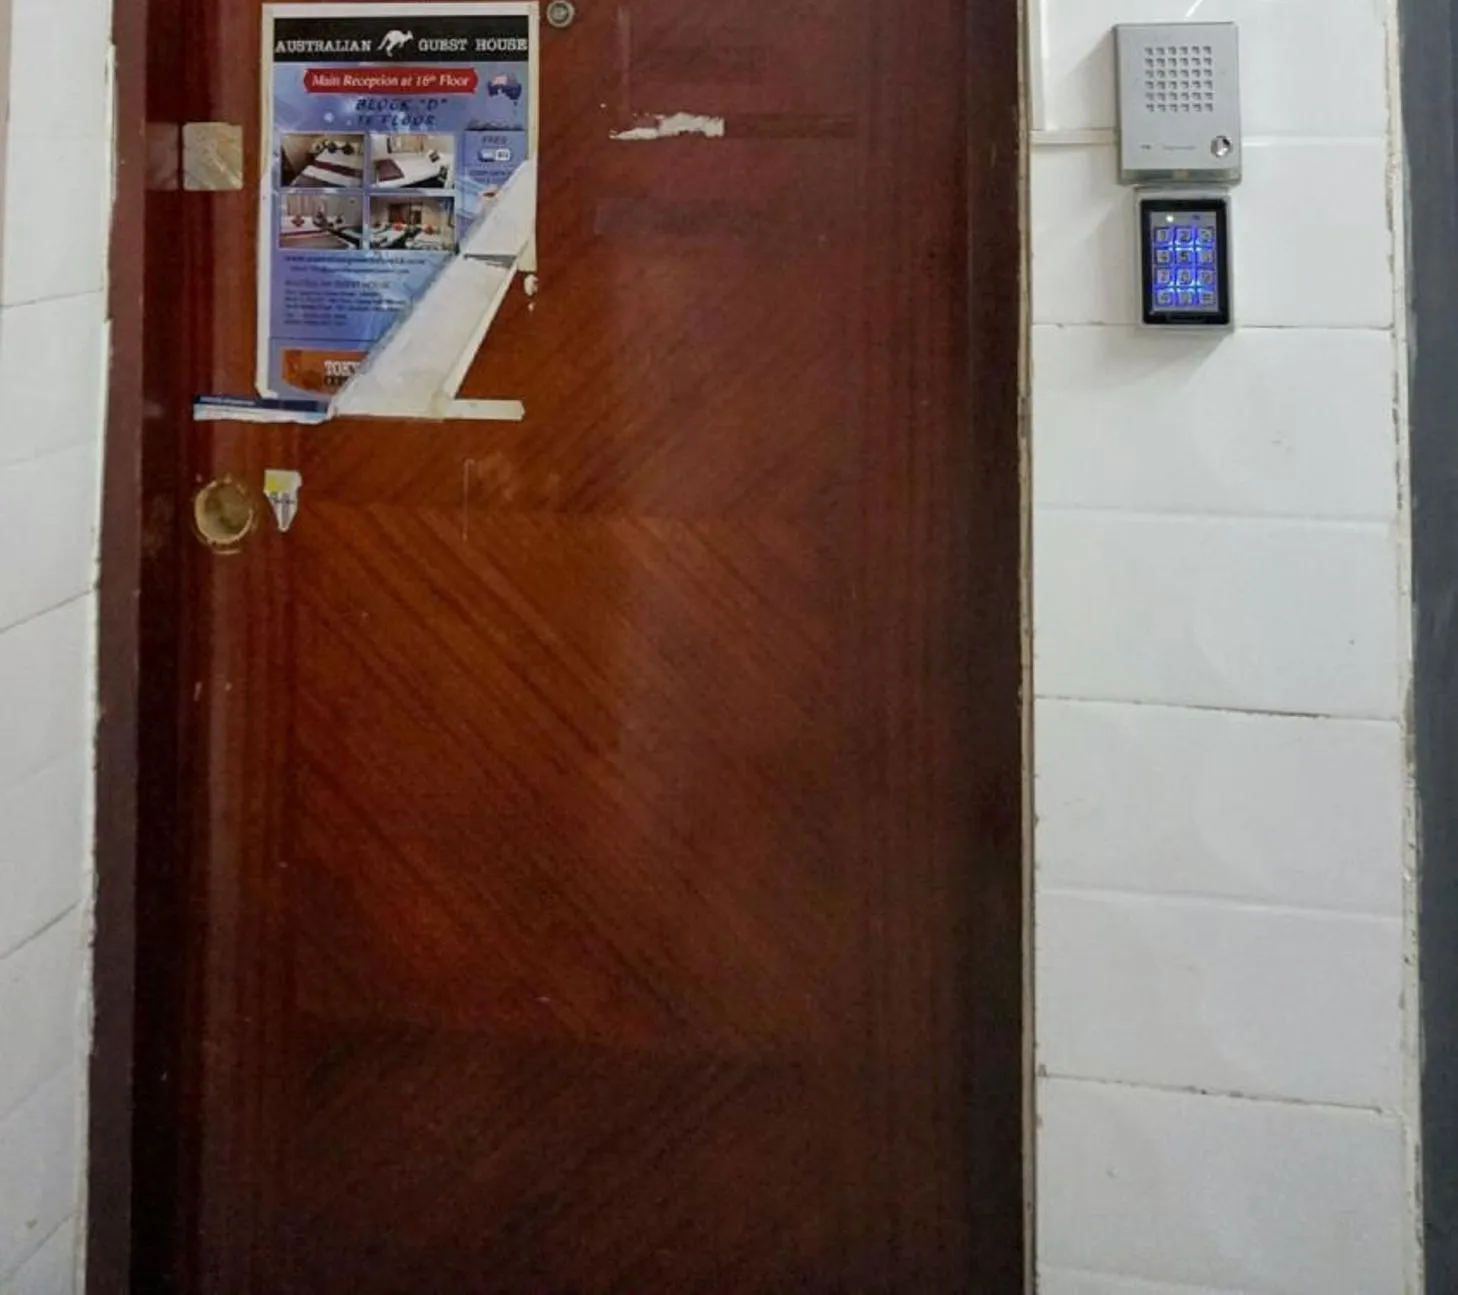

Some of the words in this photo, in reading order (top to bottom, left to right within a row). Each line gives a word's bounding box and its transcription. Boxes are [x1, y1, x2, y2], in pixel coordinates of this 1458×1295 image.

[275, 39, 373, 53] AUSTRALIAN
[418, 38, 468, 52] GUEST
[475, 37, 528, 51] HOUSE
[312, 74, 340, 87] Main
[342, 74, 399, 90] Reception
[401, 75, 413, 87] at
[439, 73, 470, 87] Floor
